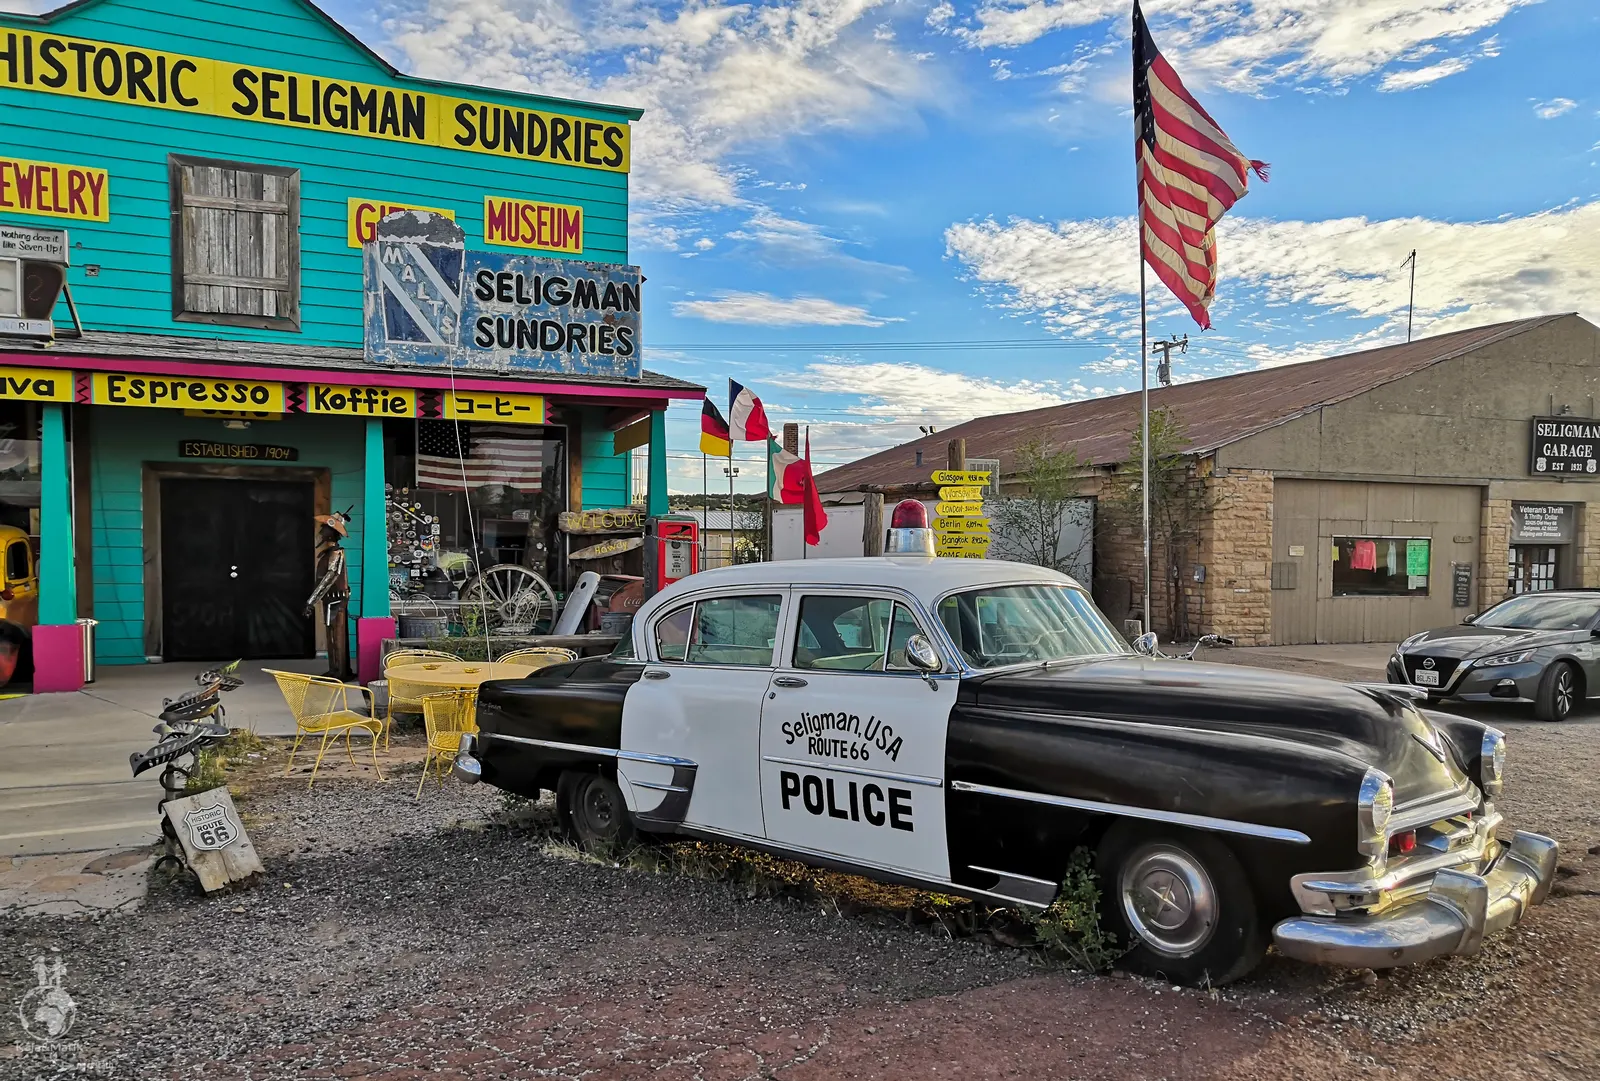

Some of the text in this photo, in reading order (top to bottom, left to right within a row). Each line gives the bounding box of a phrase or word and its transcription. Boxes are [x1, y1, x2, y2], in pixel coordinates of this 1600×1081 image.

[0, 33, 624, 168] HISTORIC SELIGMAN SUNDRIES
[487, 199, 580, 250] MUSEUM
[1, 230, 59, 243] Nothing does it
[2, 240, 63, 255] like Seven-Up!
[382, 246, 454, 335] MALTS
[475, 270, 641, 313] SELIGMAN
[475, 316, 635, 357] SUNDRIES
[107, 375, 270, 405] Espresso
[314, 385, 408, 414] Koffie
[455, 396, 531, 417] コーヒー
[1537, 422, 1600, 439] SELIGMAN
[185, 442, 290, 460] ESTABLISHED 1904
[1542, 443, 1593, 458] GARAGE
[1552, 462, 1564, 471] EST
[938, 472, 964, 483] Glasgow
[1519, 505, 1547, 513] Veteran's
[567, 513, 645, 529] WELCOME
[939, 519, 961, 528] Berlin
[941, 535, 968, 546] Bangkok
[781, 712, 904, 762] Seligman, USA
[808, 737, 870, 761] ROUTE 66
[780, 770, 914, 833] POLICE
[191, 809, 221, 823] HISTORIC
[196, 820, 224, 833] ROUTE
[200, 826, 230, 846] 66
